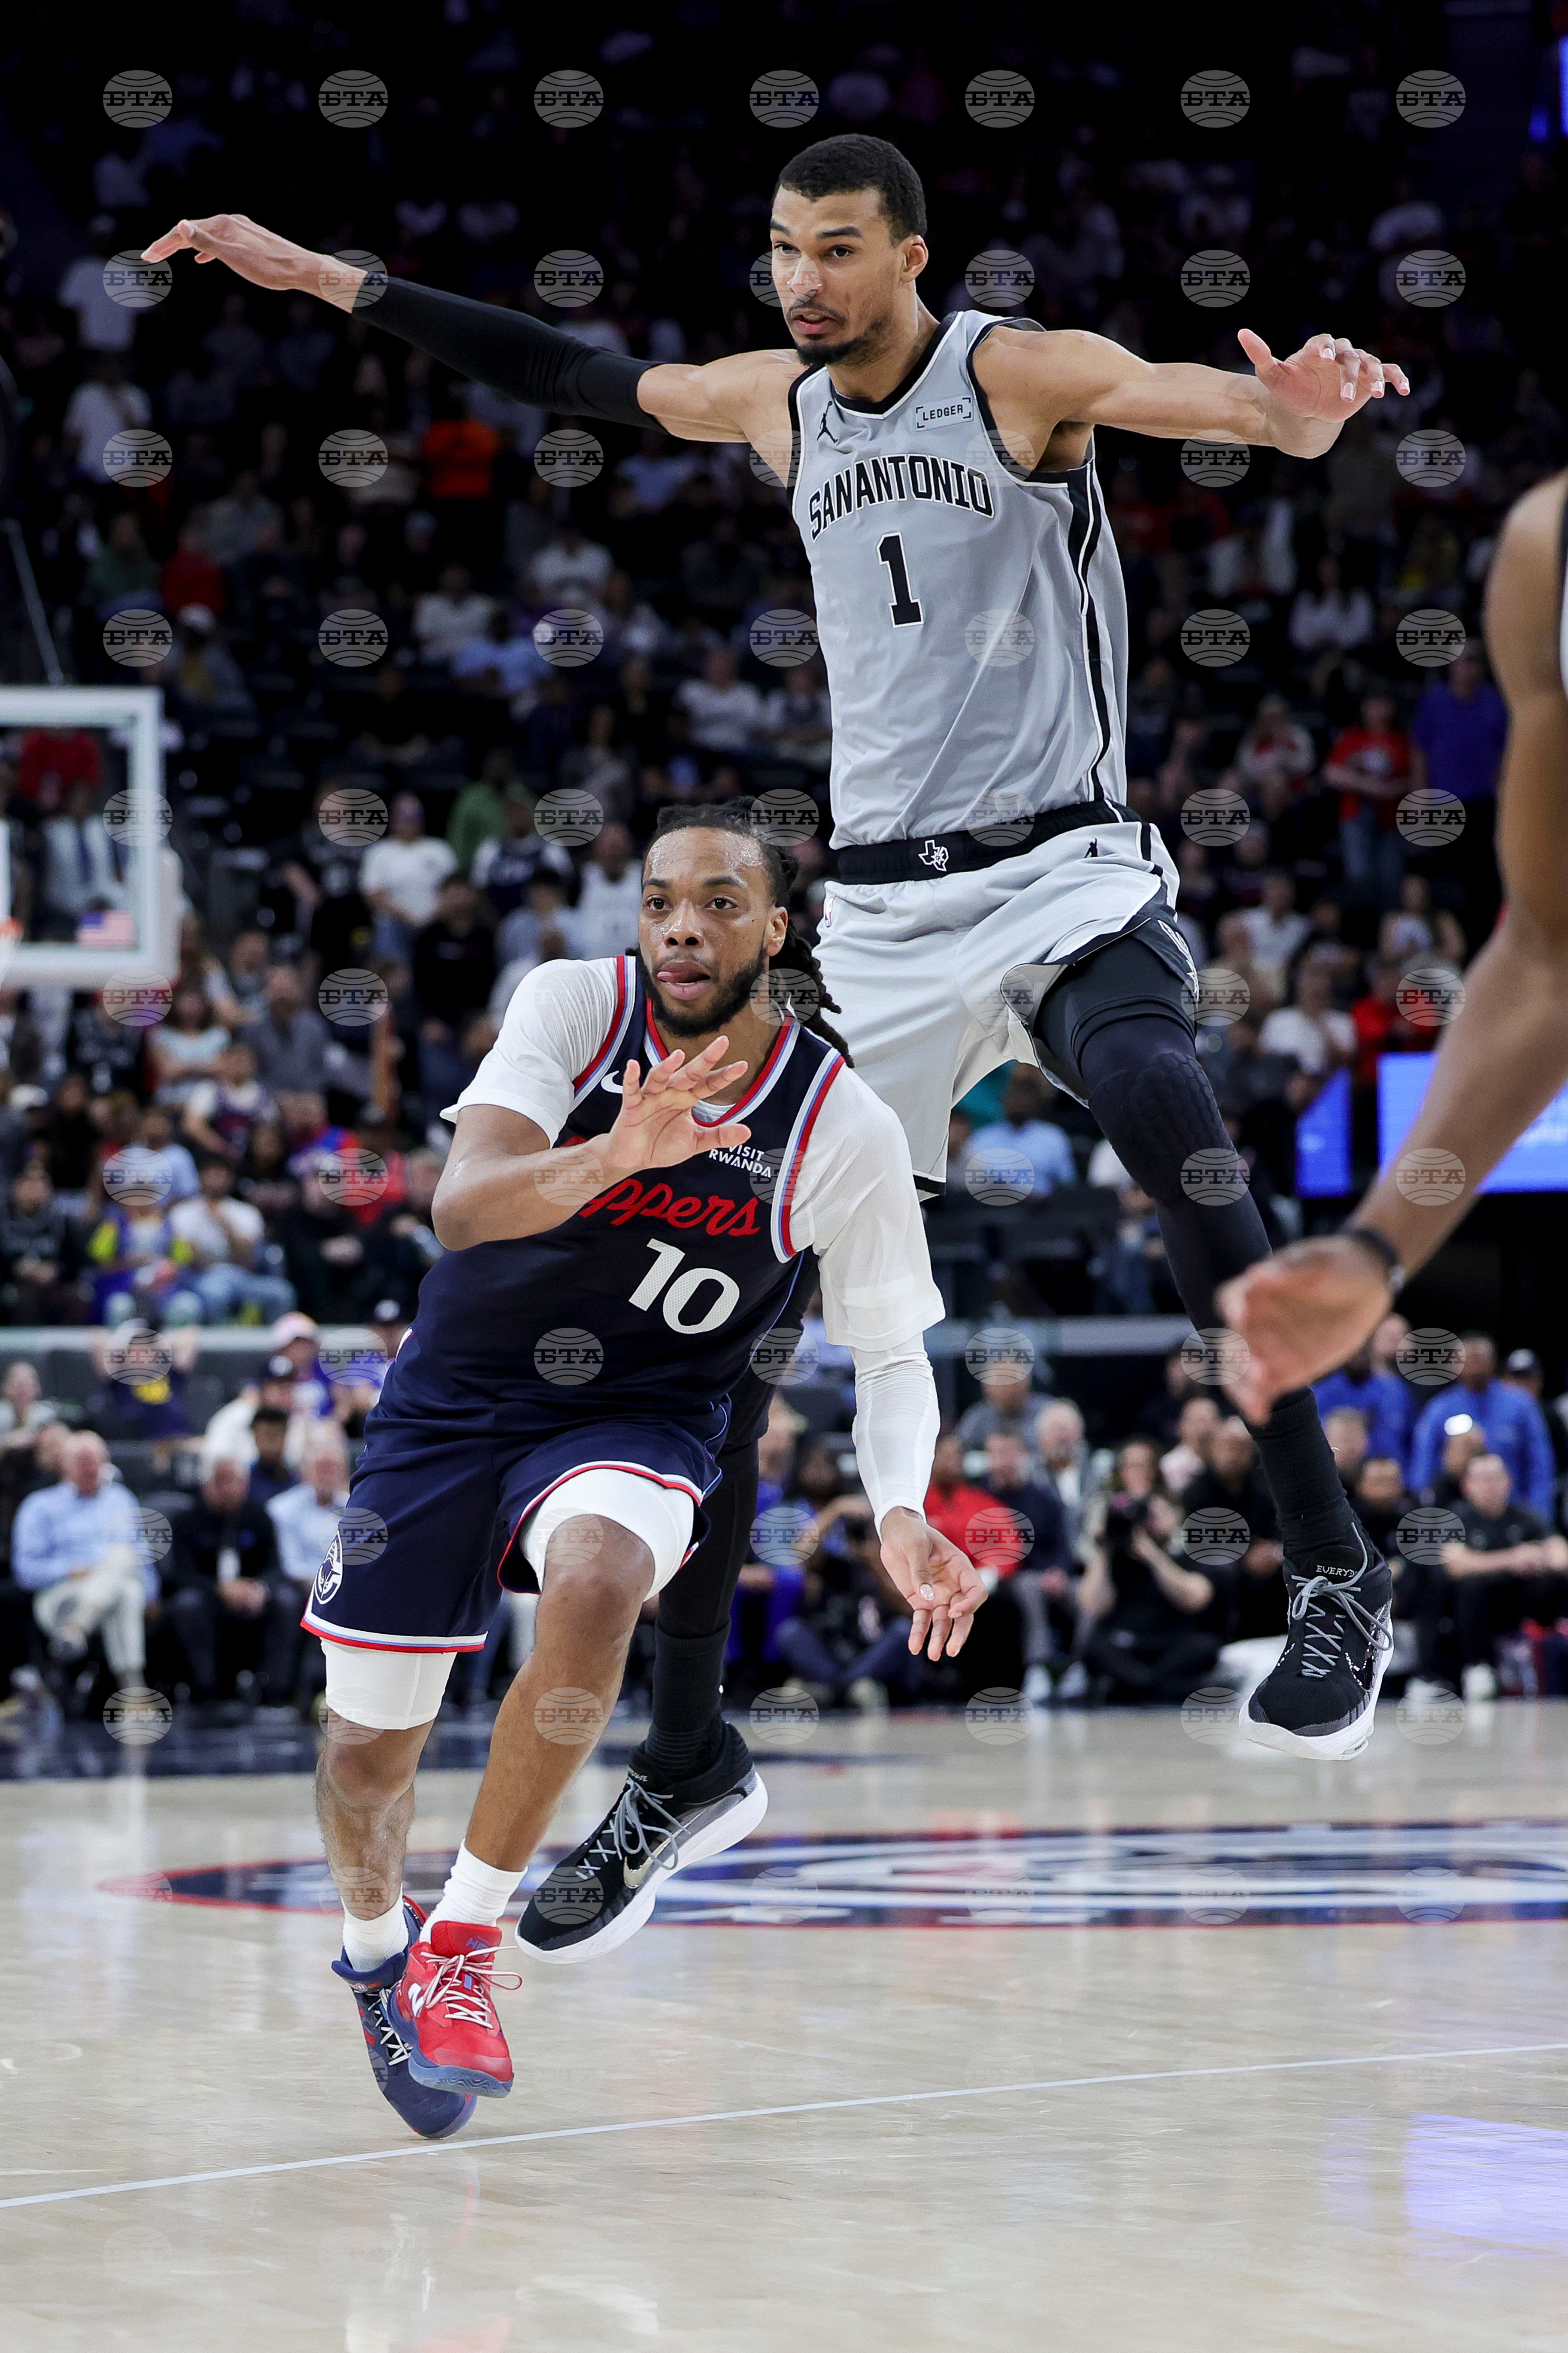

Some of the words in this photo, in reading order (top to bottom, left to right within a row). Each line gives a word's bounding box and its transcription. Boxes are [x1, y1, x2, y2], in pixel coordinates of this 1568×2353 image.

[923, 404, 963, 421] LEDGER
[876, 532, 924, 628] 1
[708, 1149, 771, 1178] RWANDA
[729, 1144, 765, 1161] VISIT
[578, 1179, 762, 1237] ppers
[629, 1238, 740, 1334] 10
[1315, 1564, 1357, 1578] EVERYD
